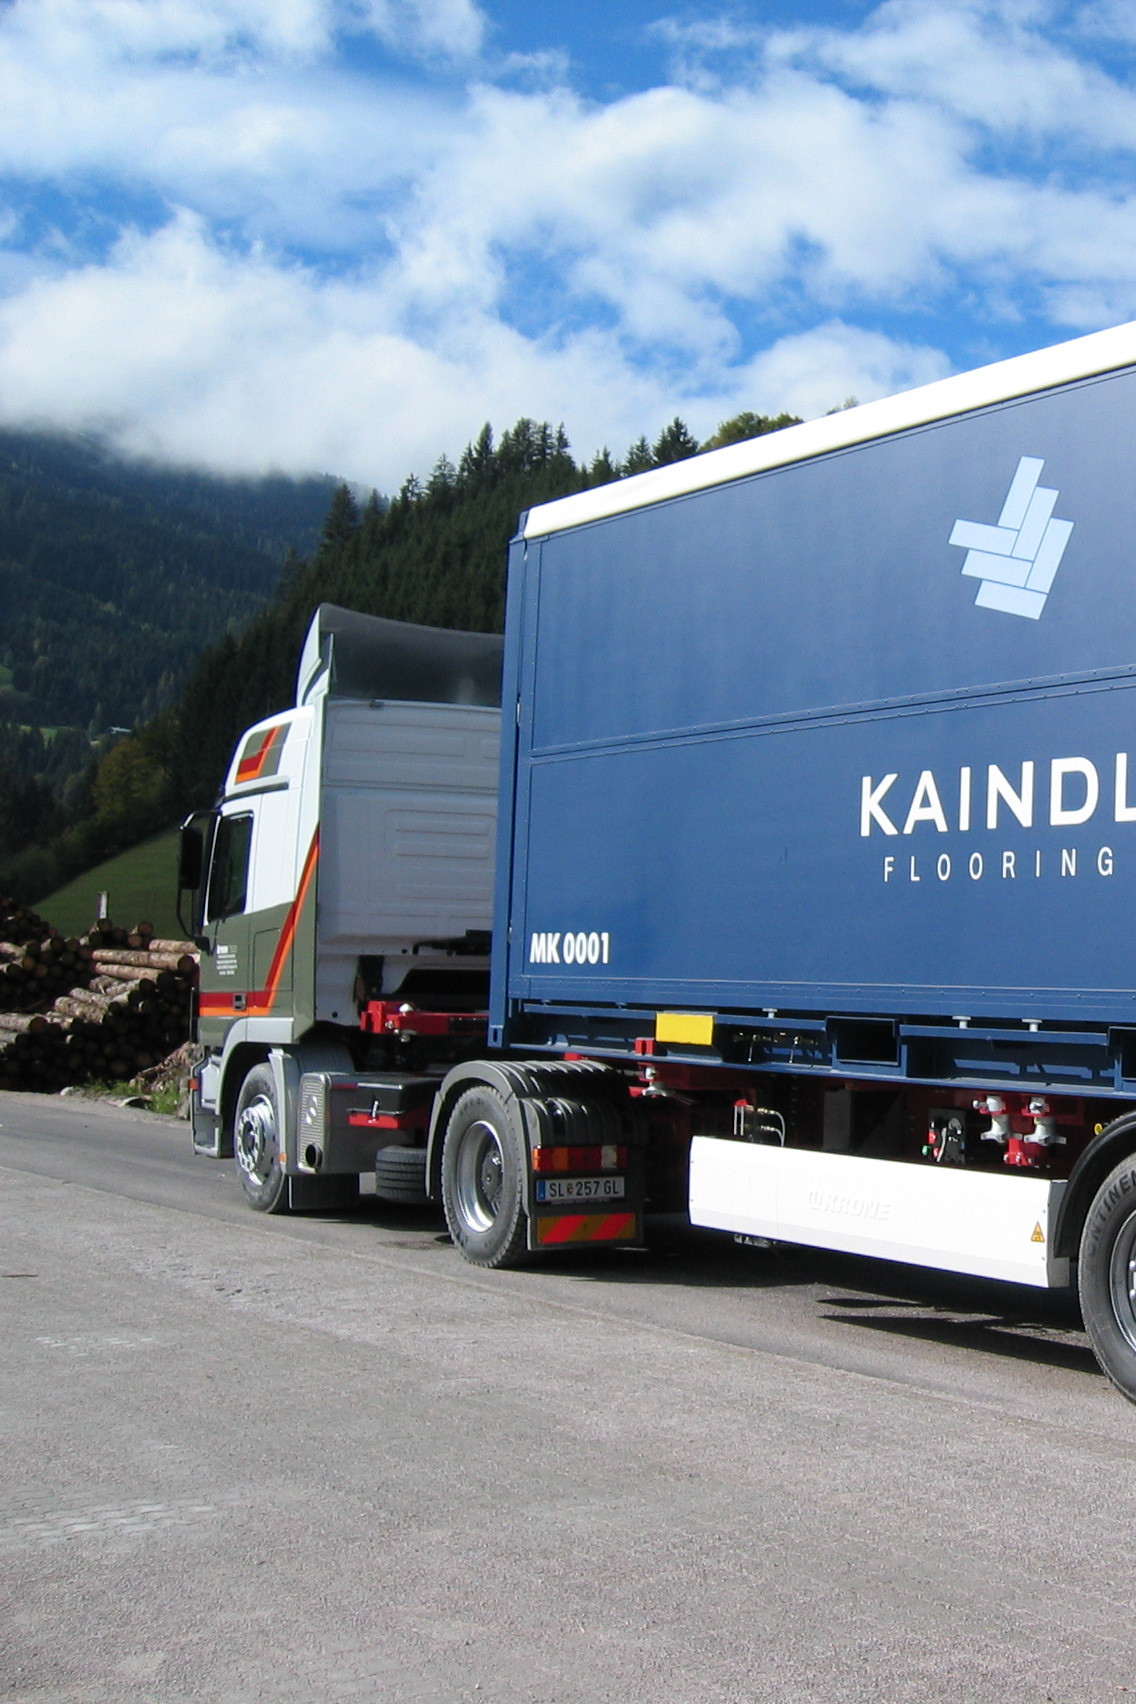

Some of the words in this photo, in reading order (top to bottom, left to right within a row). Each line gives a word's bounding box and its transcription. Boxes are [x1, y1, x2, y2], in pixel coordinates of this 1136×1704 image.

[884, 846, 1113, 882] FLOORING
[529, 932, 561, 964] MK
[562, 931, 610, 965] 0001
[549, 1182, 564, 1197] SL
[575, 1180, 600, 1196] 257
[604, 1180, 620, 1195] GL
[824, 1194, 892, 1221] KRONE
